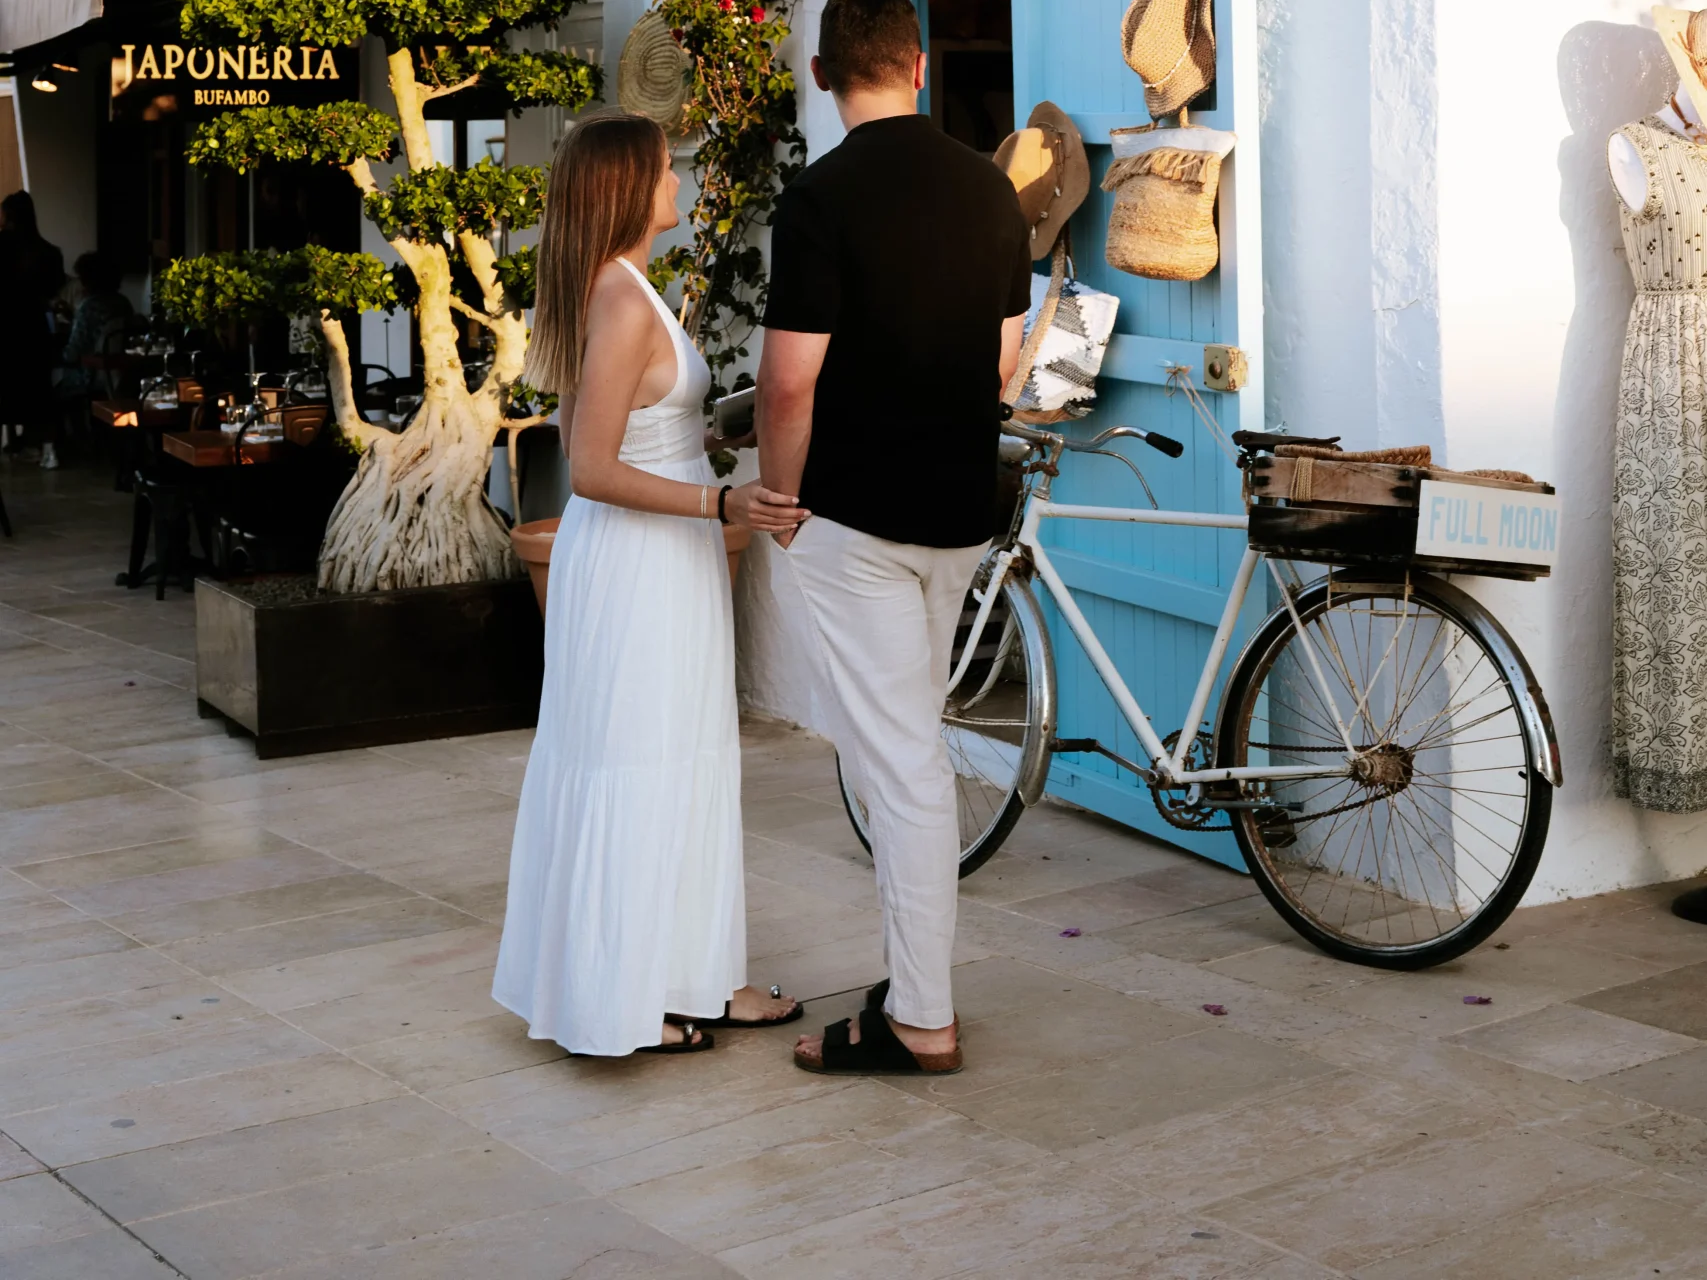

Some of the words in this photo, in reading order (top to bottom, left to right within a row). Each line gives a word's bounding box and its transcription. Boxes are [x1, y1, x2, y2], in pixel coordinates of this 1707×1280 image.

[120, 44, 340, 89] JAPONERIA
[194, 89, 270, 106] BUFAMBO
[1429, 496, 1488, 546] FULL
[1498, 503, 1557, 552] MOON
